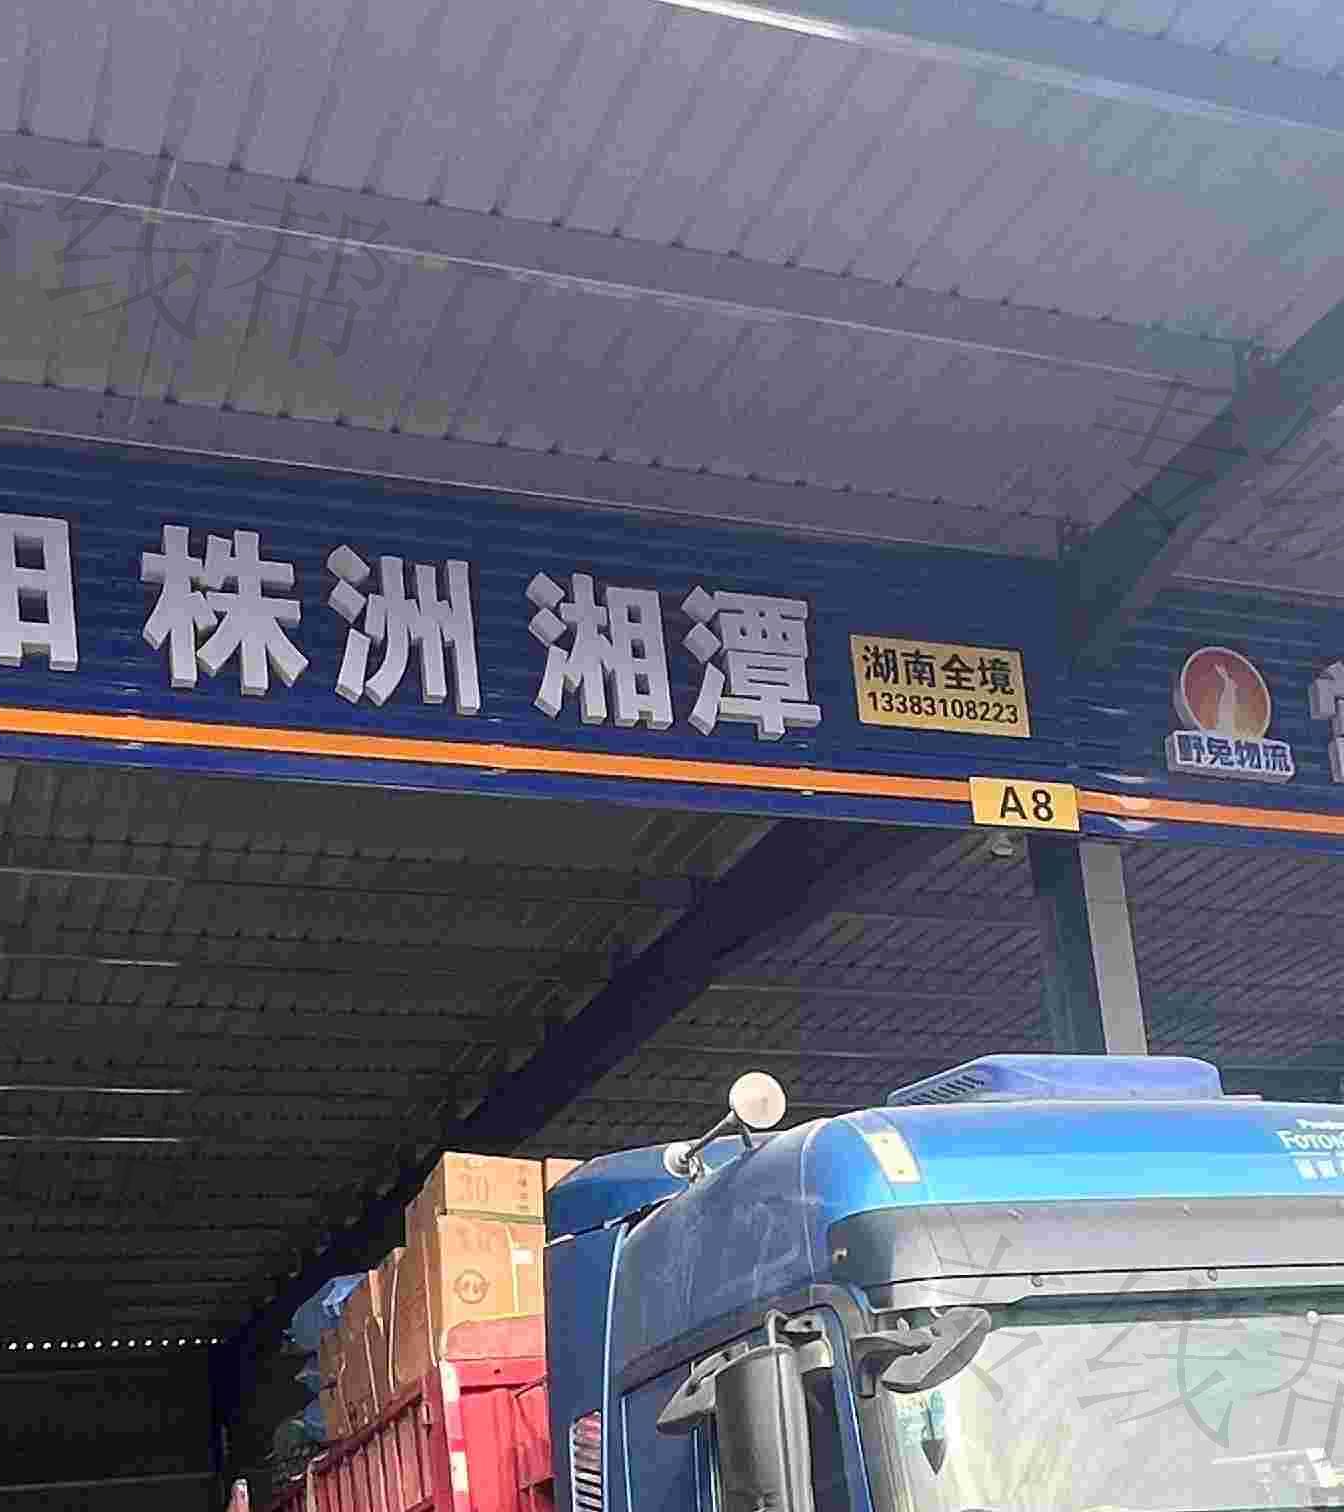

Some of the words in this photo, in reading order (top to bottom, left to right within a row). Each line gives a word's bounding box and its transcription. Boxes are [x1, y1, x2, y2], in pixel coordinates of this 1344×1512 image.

[139, 525, 481, 714] 株洲
[526, 573, 821, 740] 湘潭
[862, 645, 1015, 696] 湖南全境
[867, 691, 1019, 724] 13383108223
[1176, 733, 1293, 774] 野兔物流
[998, 785, 1055, 824] A8
